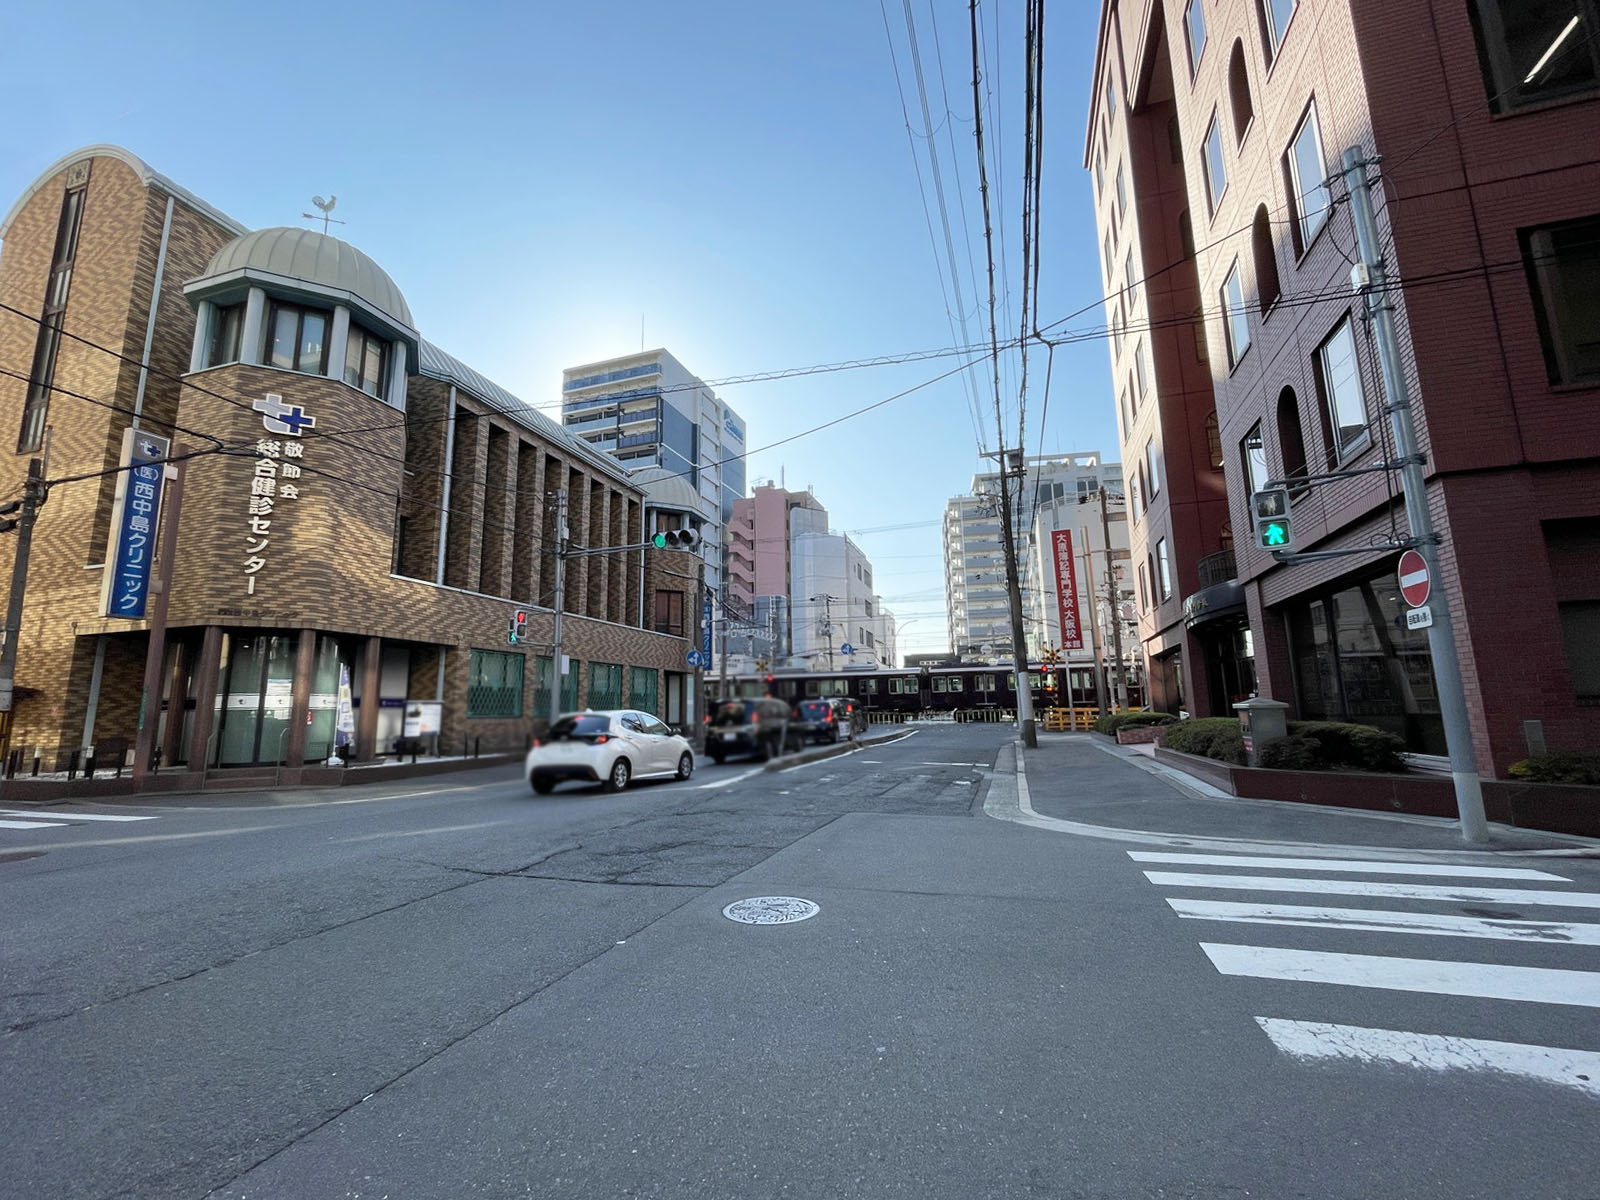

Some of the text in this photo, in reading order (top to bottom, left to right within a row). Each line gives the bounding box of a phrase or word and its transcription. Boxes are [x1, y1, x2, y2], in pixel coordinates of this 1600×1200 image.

[243, 438, 281, 595] 総合健診センター
